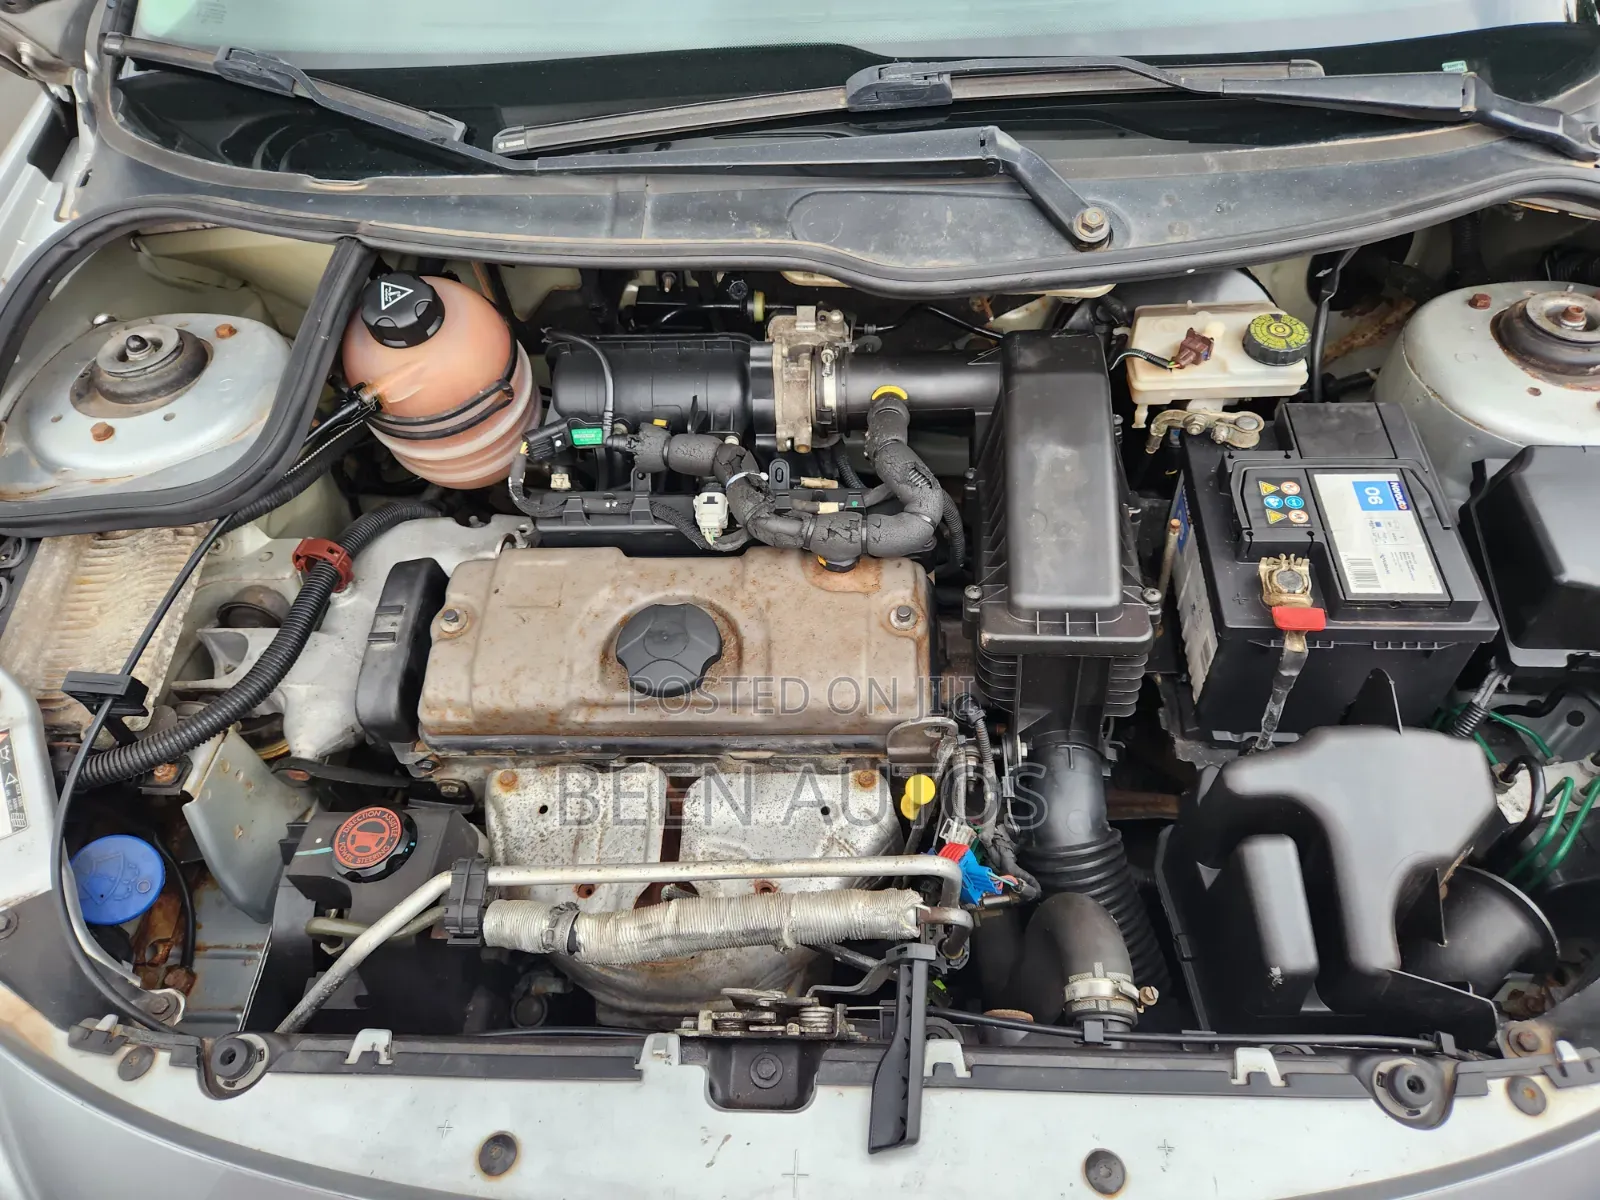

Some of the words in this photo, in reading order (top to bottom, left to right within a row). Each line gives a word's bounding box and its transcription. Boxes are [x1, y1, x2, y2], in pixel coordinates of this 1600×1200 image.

[1364, 487, 1384, 505] 06
[345, 810, 382, 834] DIRECTION
[338, 841, 355, 863] POWER
[355, 844, 391, 864] STEERING
